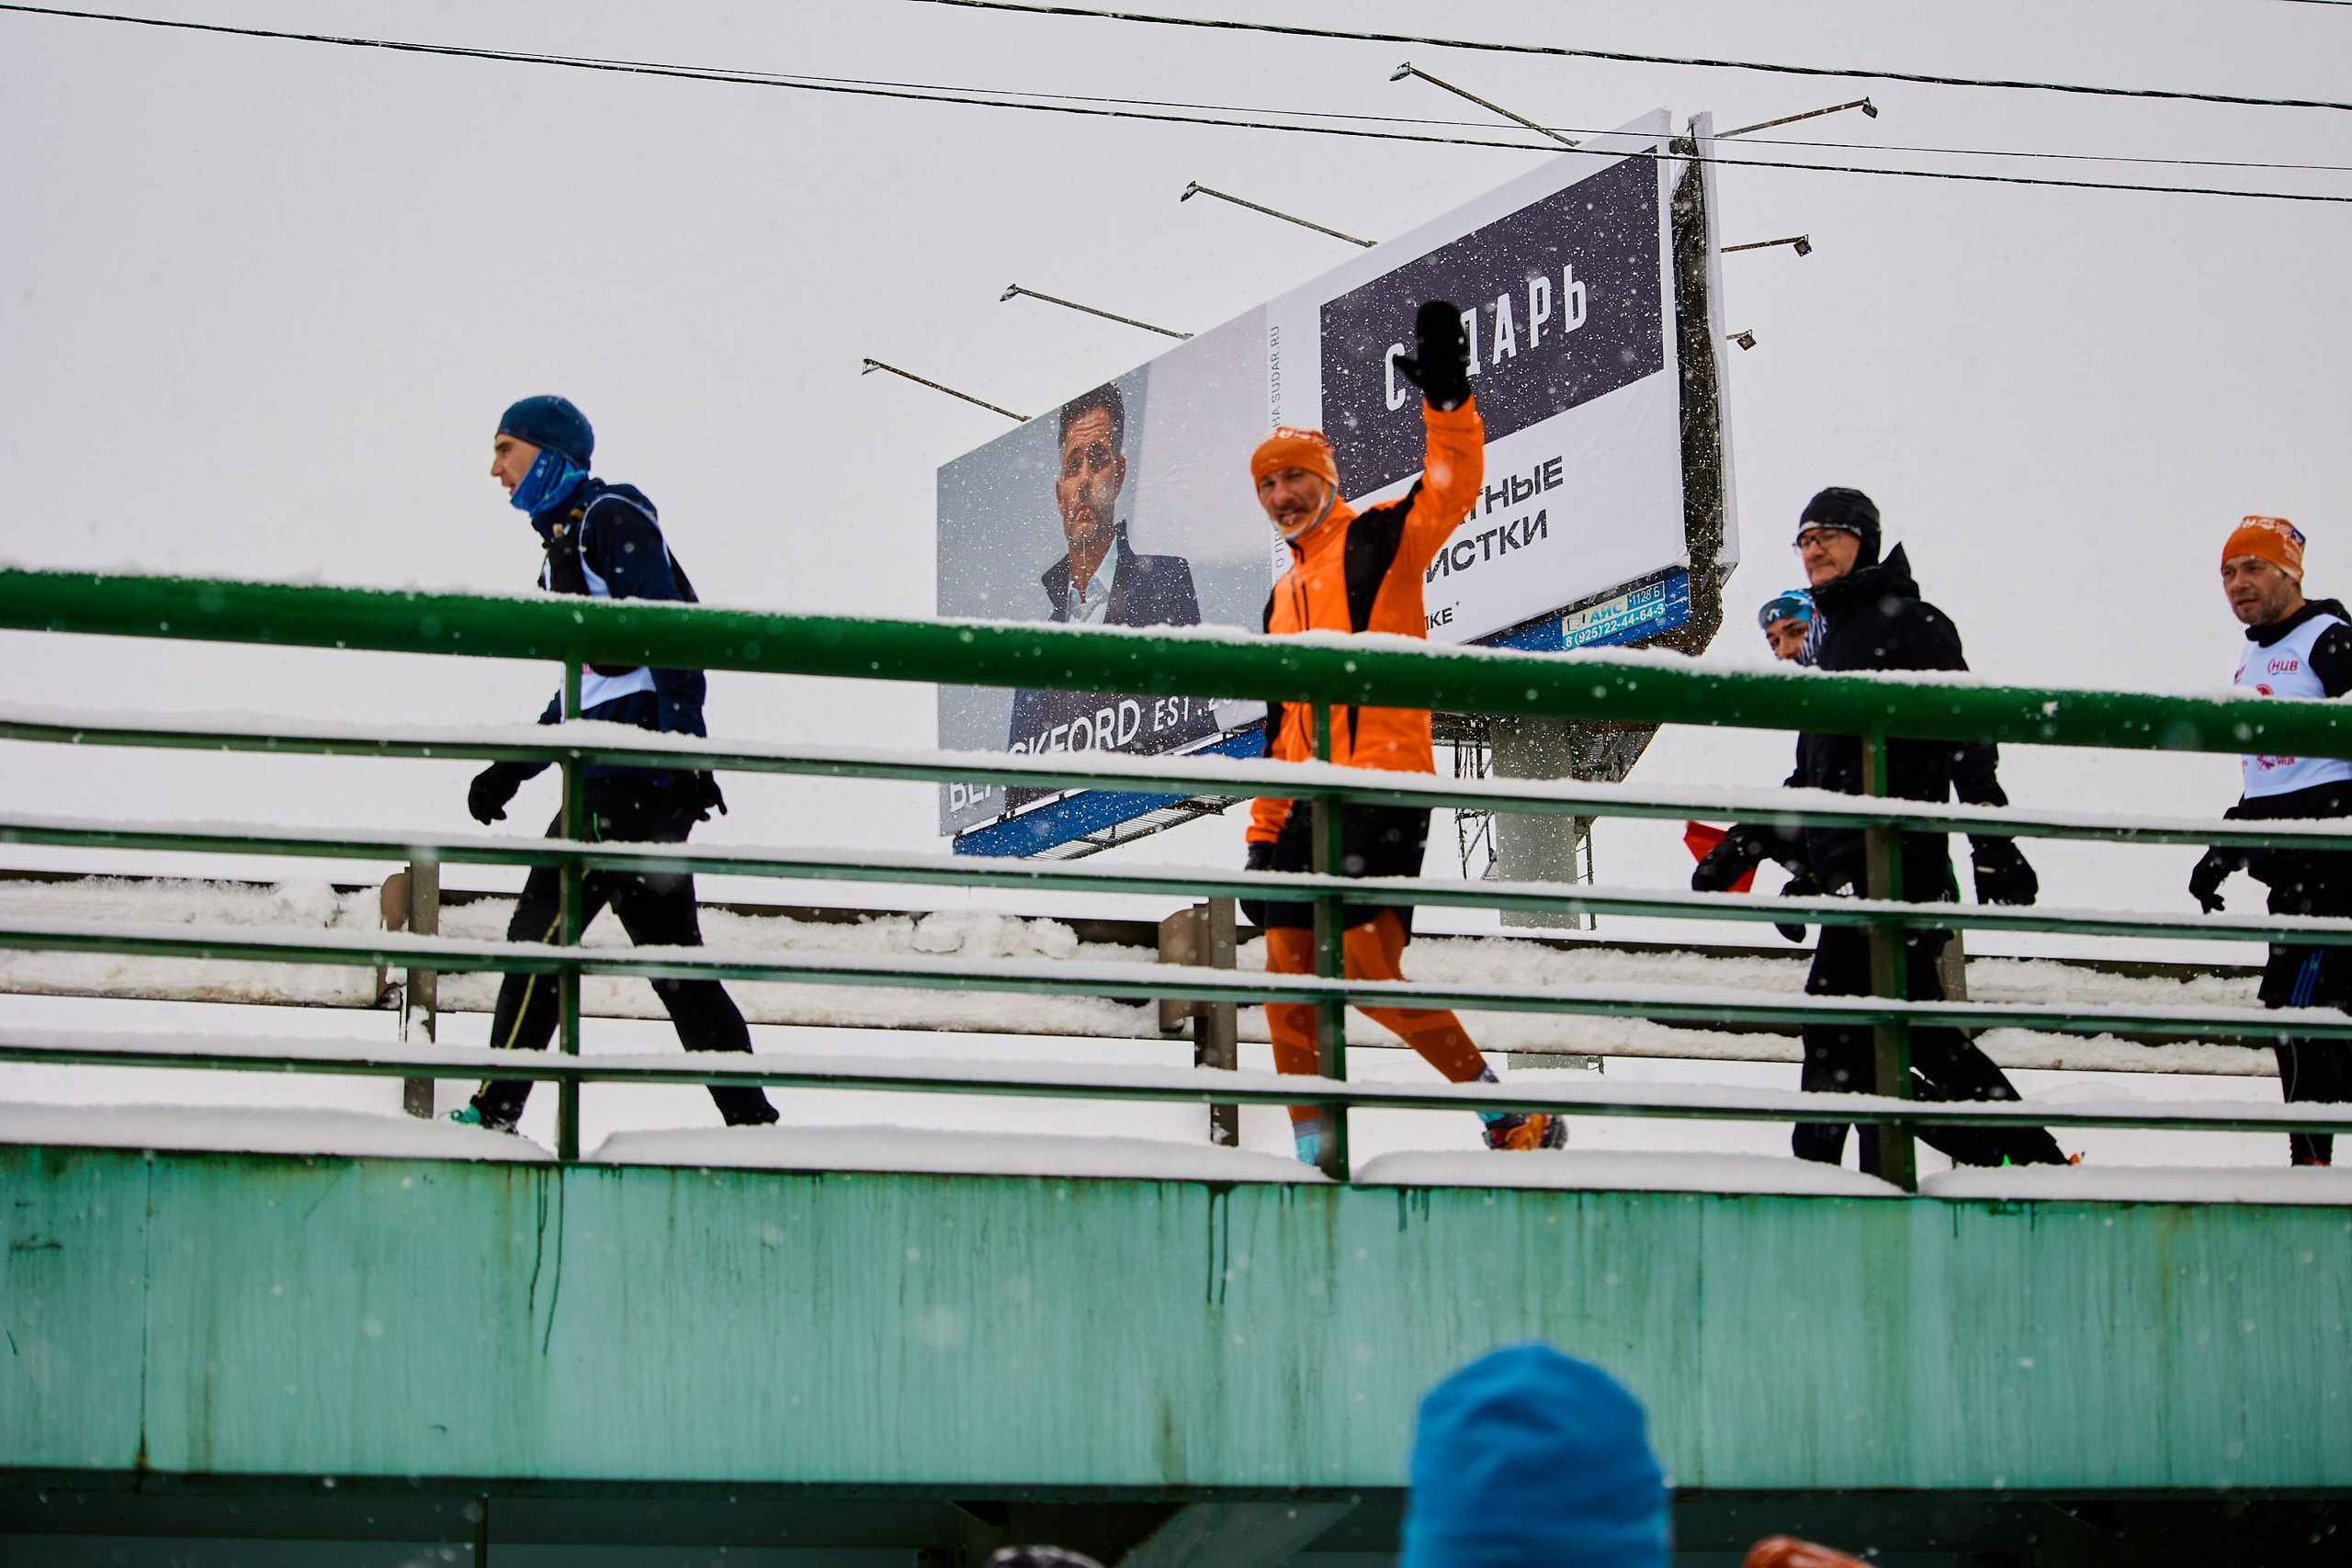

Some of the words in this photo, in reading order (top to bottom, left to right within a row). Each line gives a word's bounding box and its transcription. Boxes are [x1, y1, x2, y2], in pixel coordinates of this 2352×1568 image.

[1271, 326, 1281, 403] SUDAR.RU
[1385, 264, 1588, 412] СДАРЬ
[1272, 406, 1281, 428] НА
